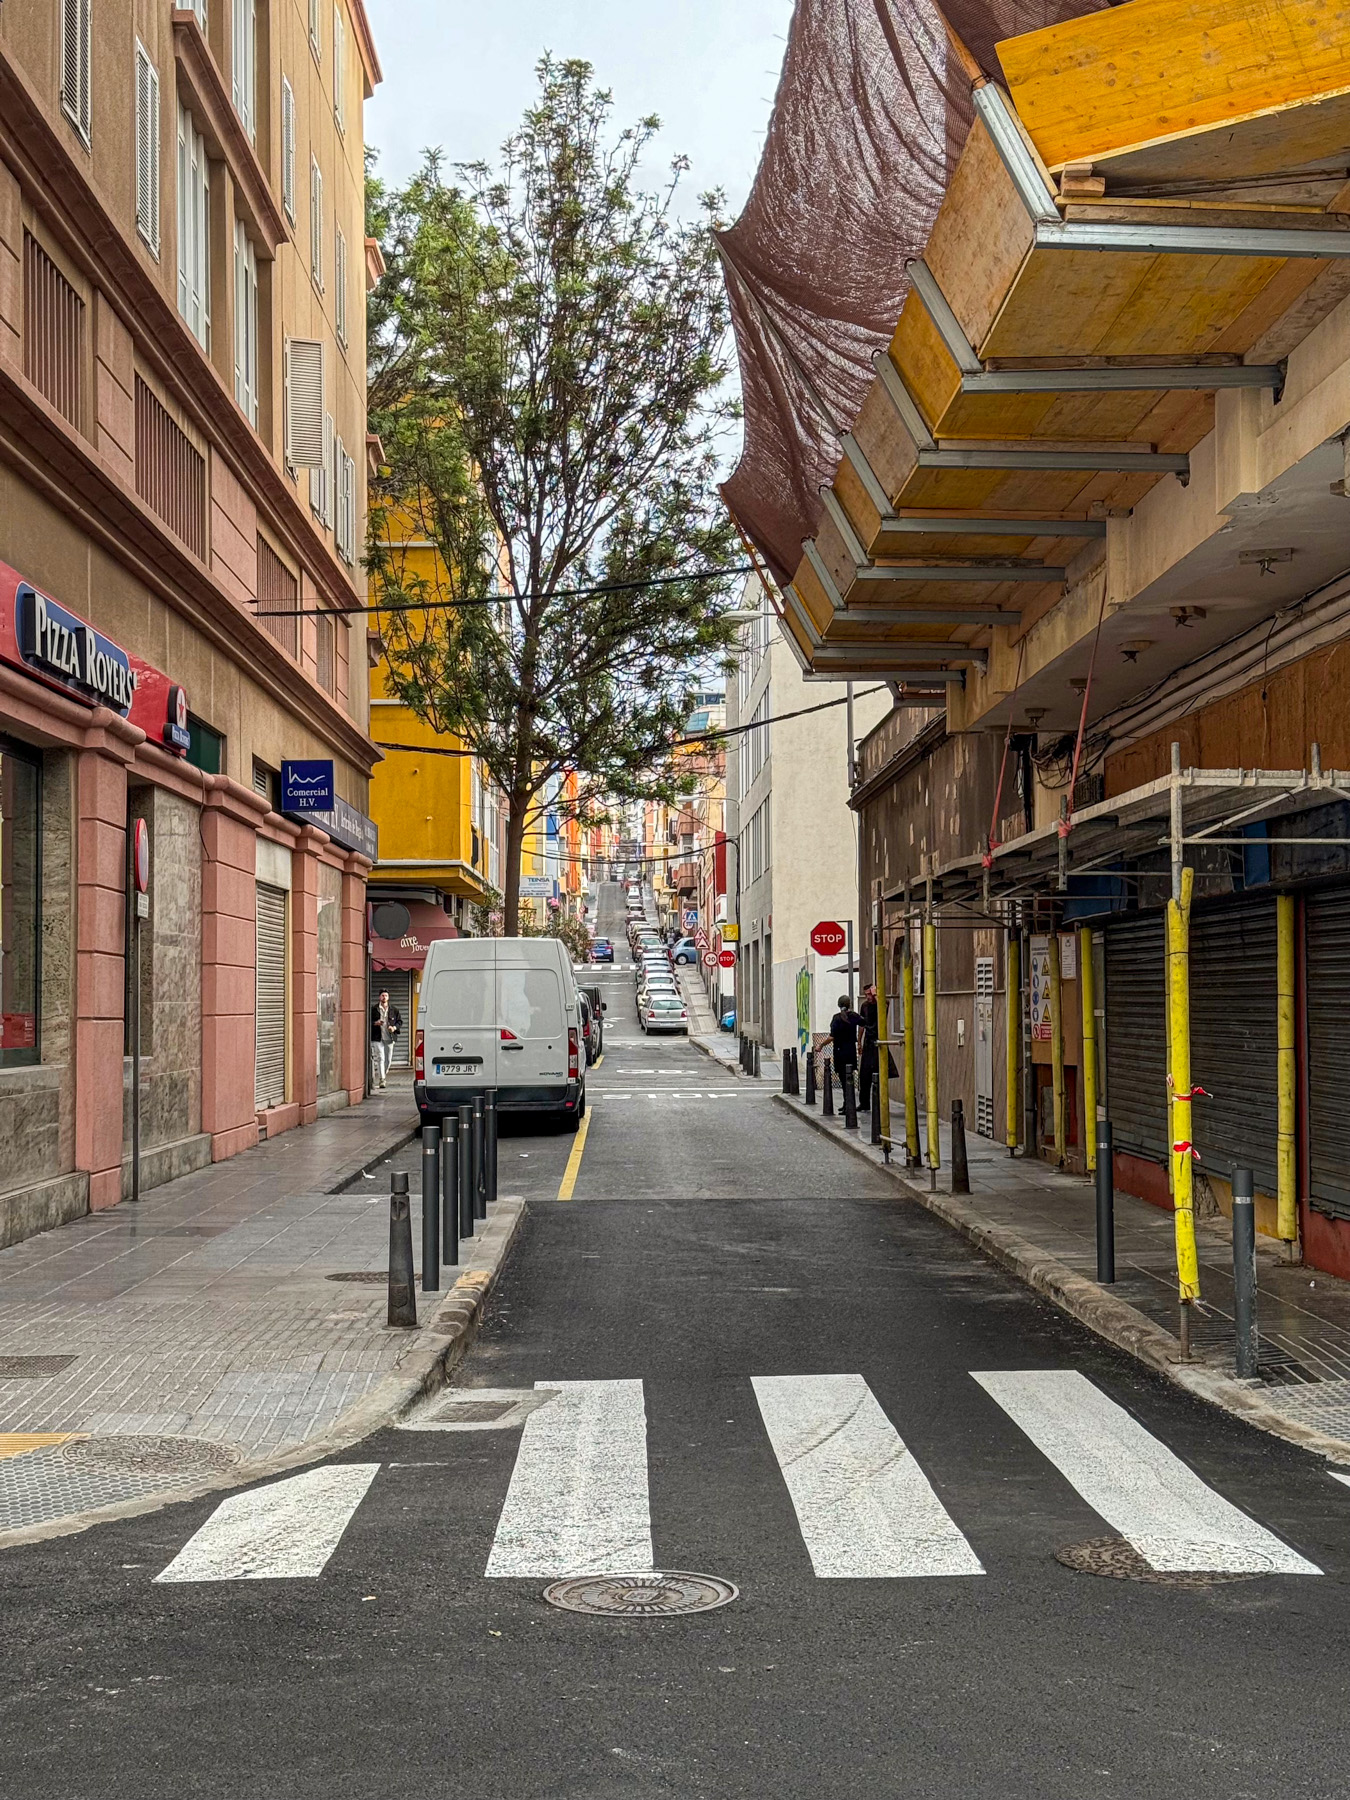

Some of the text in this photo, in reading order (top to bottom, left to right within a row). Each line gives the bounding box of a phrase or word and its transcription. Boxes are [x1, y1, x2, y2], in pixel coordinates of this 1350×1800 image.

[34, 593, 80, 679] PIZZA
[287, 787, 329, 797] Comercial
[299, 798, 318, 807] H.V.
[400, 934, 419, 948] aire
[814, 934, 843, 943] STOP
[441, 1065, 478, 1073] 8779 JRT
